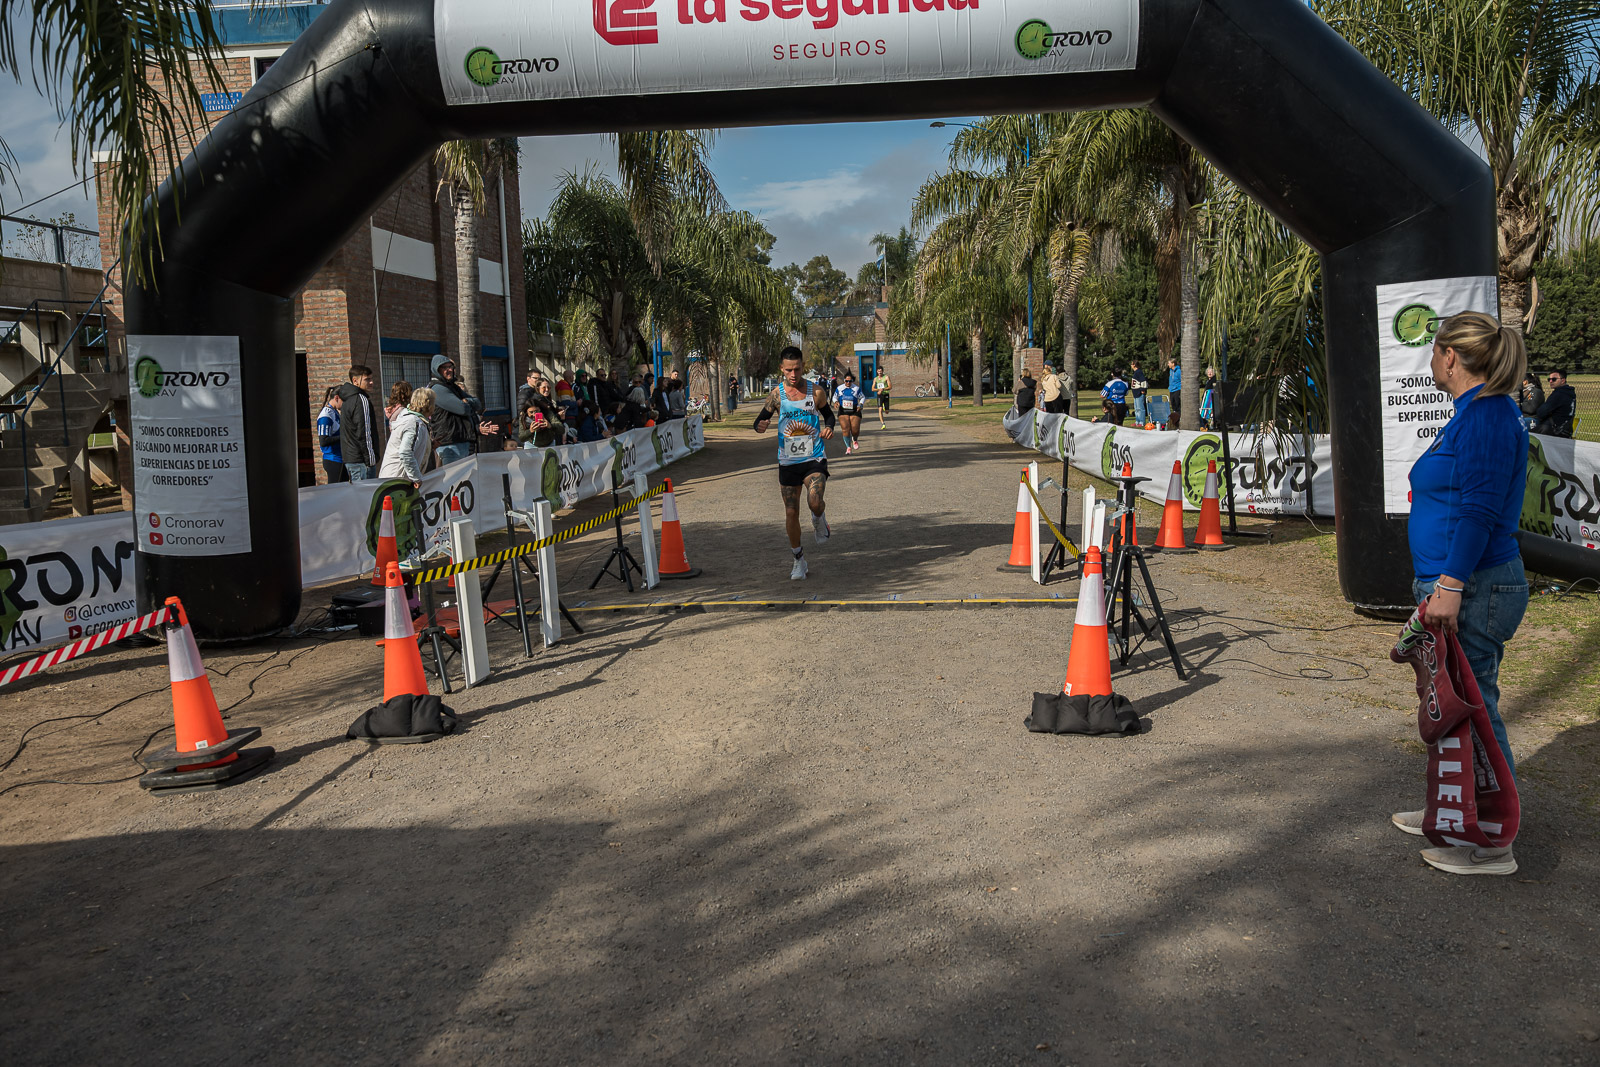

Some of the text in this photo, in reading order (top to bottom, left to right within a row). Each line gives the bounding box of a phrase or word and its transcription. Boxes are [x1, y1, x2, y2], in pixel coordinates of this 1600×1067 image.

[773, 39, 887, 60] SEGUROS
[1040, 48, 1065, 58] RAV
[491, 76, 515, 85] RAV
[153, 388, 177, 397] RAV
[1388, 392, 1444, 406] BUSCANDO
[1398, 408, 1457, 422] EXPERIENC
[166, 426, 229, 438] CORREDORES
[135, 441, 239, 454] BUSCANDO MEJORAR LAS
[790, 441, 807, 453] 64
[141, 458, 230, 470] EXPERIENCIAS DE LOS
[165, 516, 225, 529] Cronorav
[166, 533, 226, 545] Cronorav
[78, 599, 136, 621] @cronor
